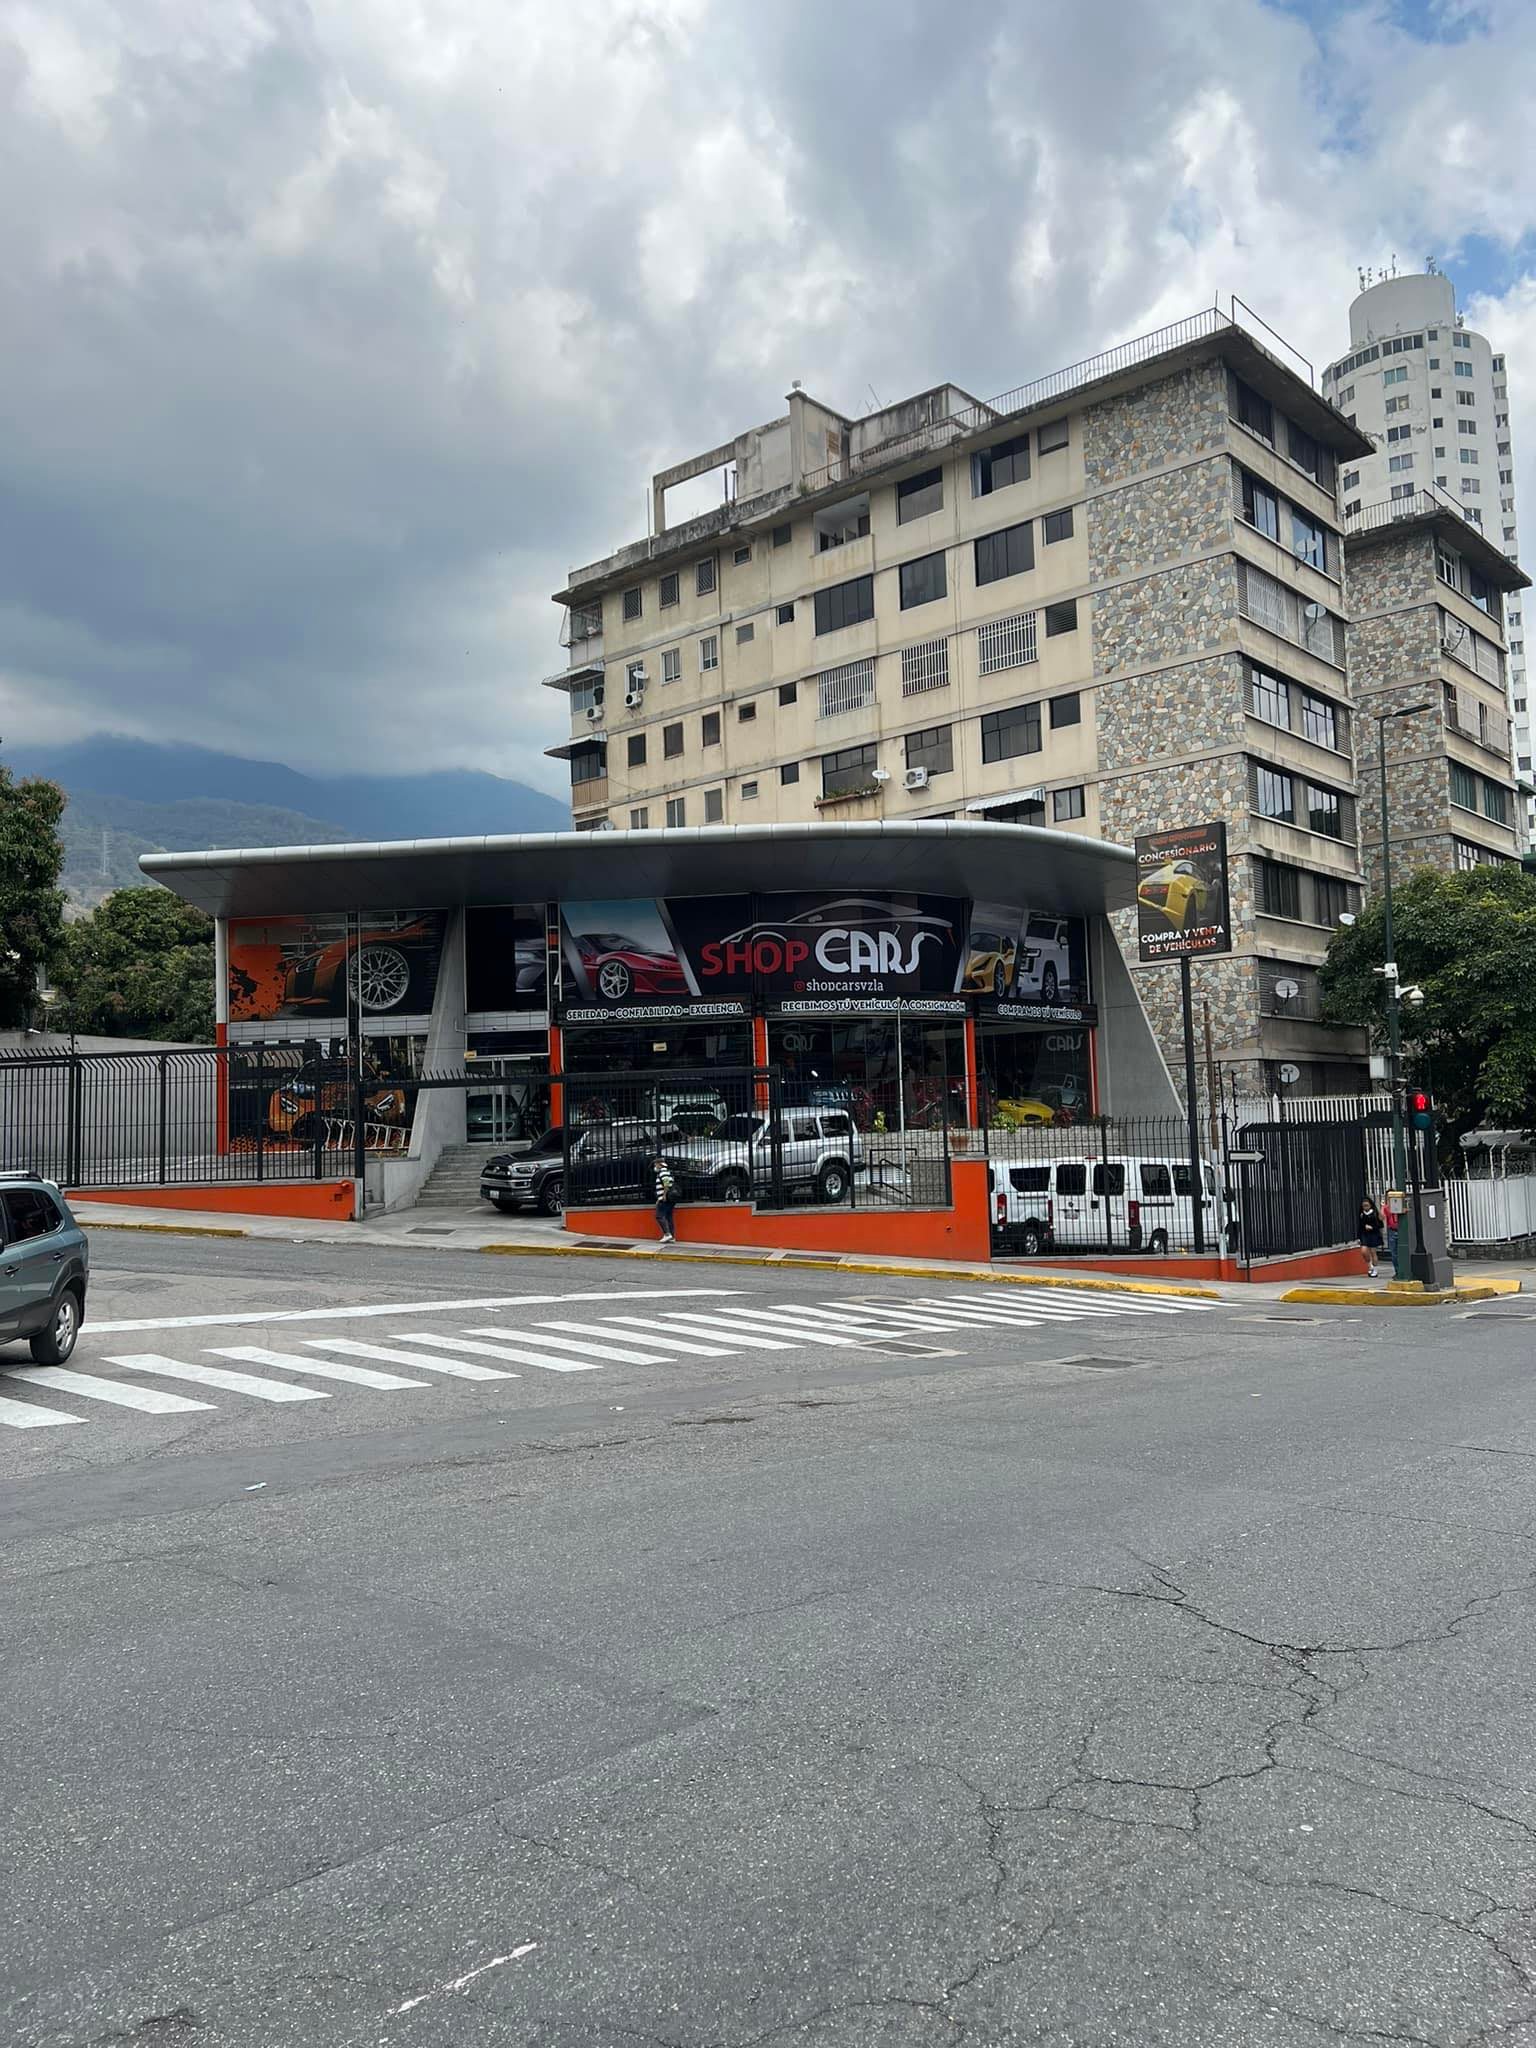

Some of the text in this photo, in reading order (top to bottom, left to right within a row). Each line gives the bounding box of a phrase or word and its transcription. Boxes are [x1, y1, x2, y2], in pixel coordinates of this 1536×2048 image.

[1141, 925, 1224, 944] COMPRA Y VENTA
[701, 928, 925, 975] SHOP CARS
[1149, 937, 1217, 954] DE VEHÍCULOS
[567, 1008, 608, 1020] SERIEDAD
[615, 1006, 683, 1019] CONFIABILIDAD
[689, 1002, 743, 1015] EXCELENCIA
[781, 1000, 837, 1012] RECIBIMOS
[850, 998, 899, 1011] VEHÍCULO
[900, 1000, 909, 1010] A
[909, 1000, 966, 1012] CONSIGNACIÓN
